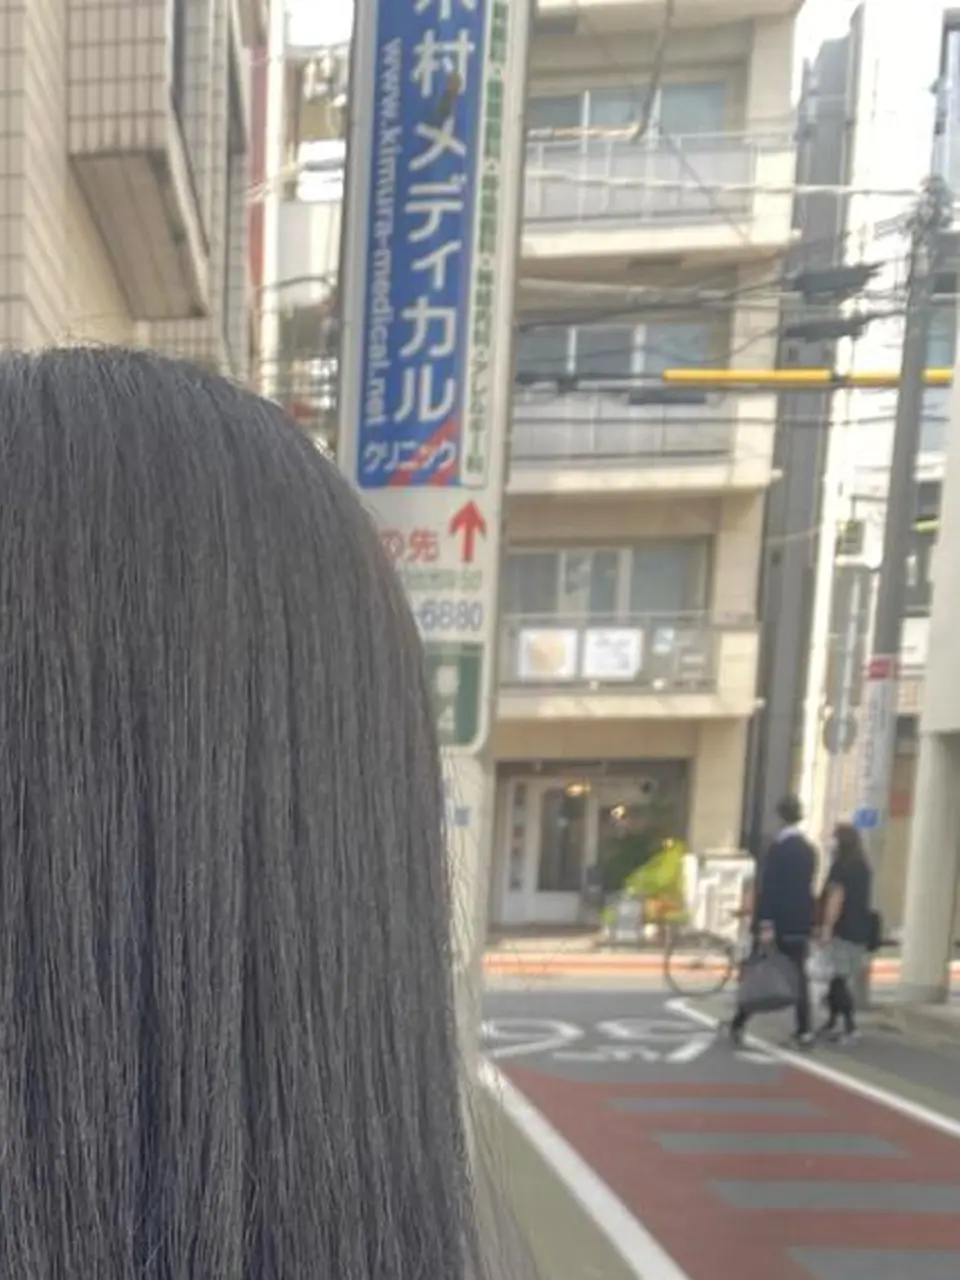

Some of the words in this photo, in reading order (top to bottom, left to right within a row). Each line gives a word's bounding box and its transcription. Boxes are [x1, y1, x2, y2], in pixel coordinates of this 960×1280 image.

[365, 37, 402, 427] www.kimura-medical.net
[364, 440, 457, 473] クリニック
